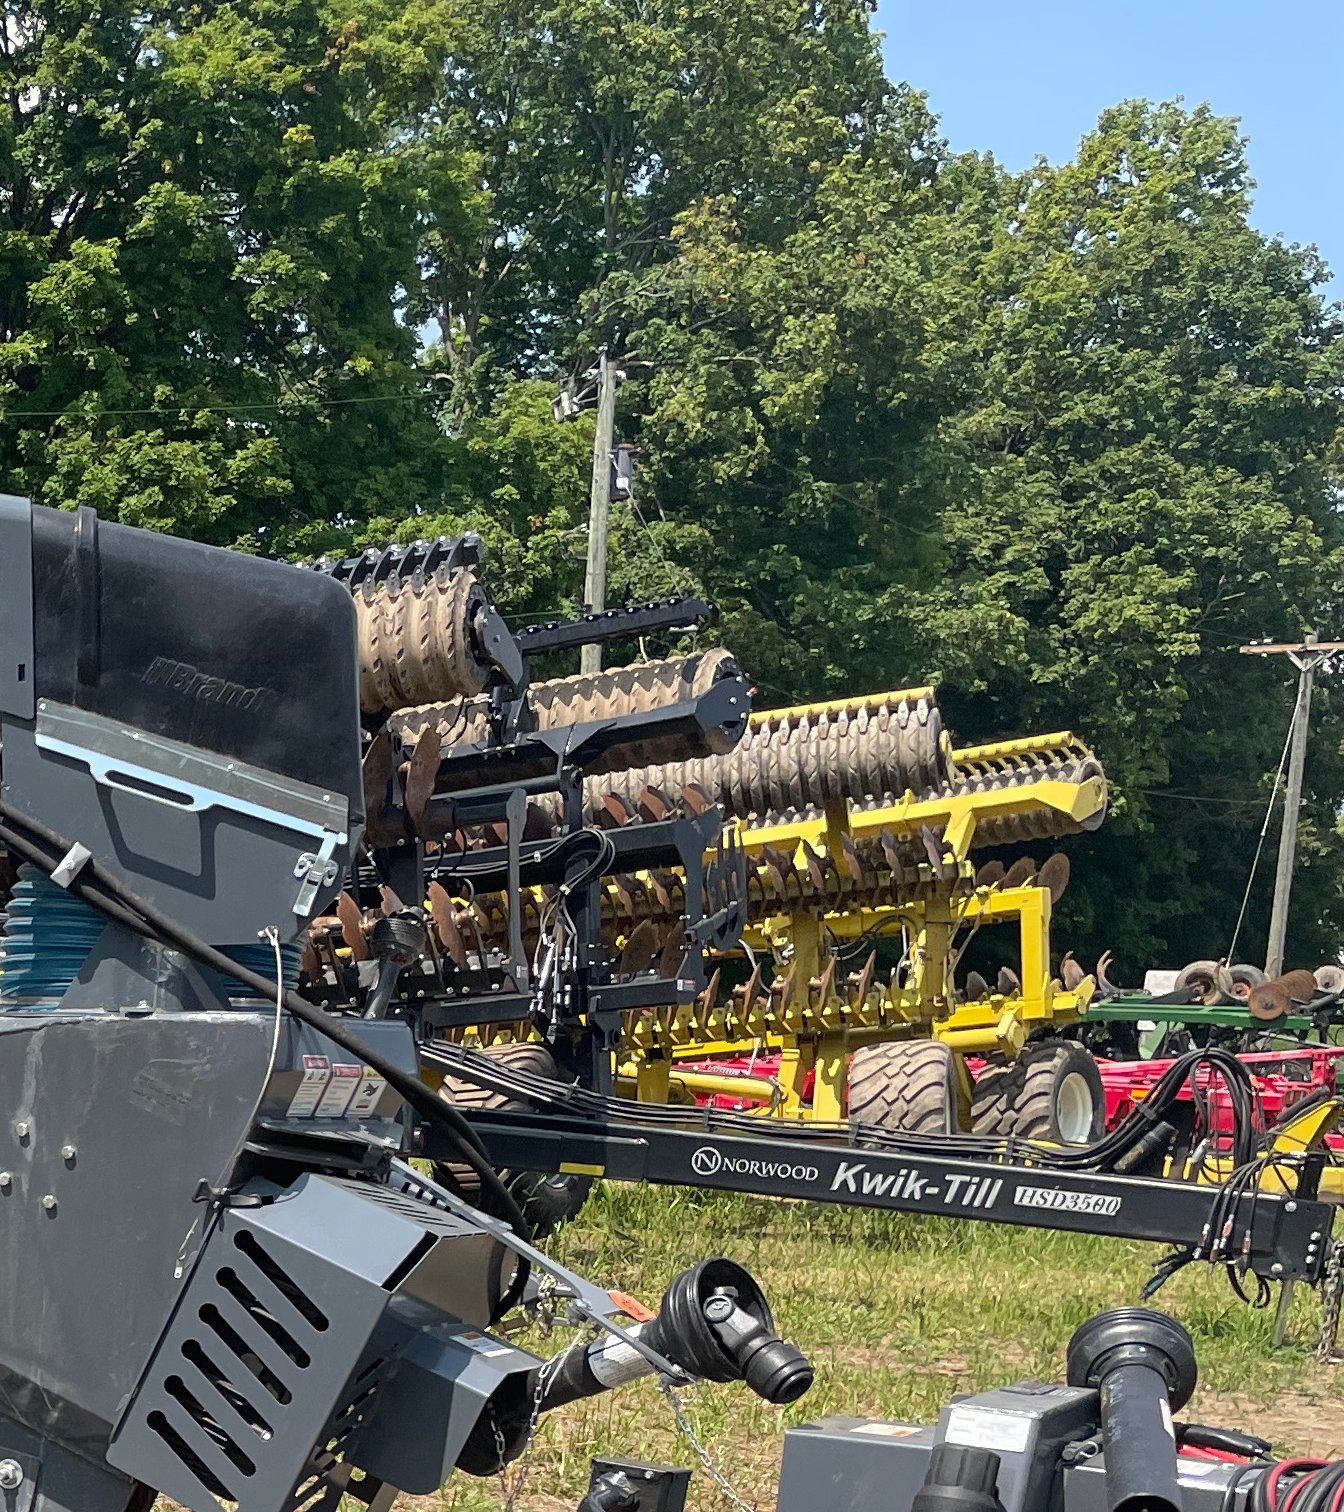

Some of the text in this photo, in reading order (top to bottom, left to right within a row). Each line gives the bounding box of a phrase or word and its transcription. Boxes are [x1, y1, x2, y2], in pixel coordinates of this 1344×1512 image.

[164, 660, 279, 713] Brand
[722, 1157, 819, 1181] NORWOOD
[829, 1161, 1004, 1209] Kwik-Till
[1017, 1187, 1120, 1215] HSD3500
